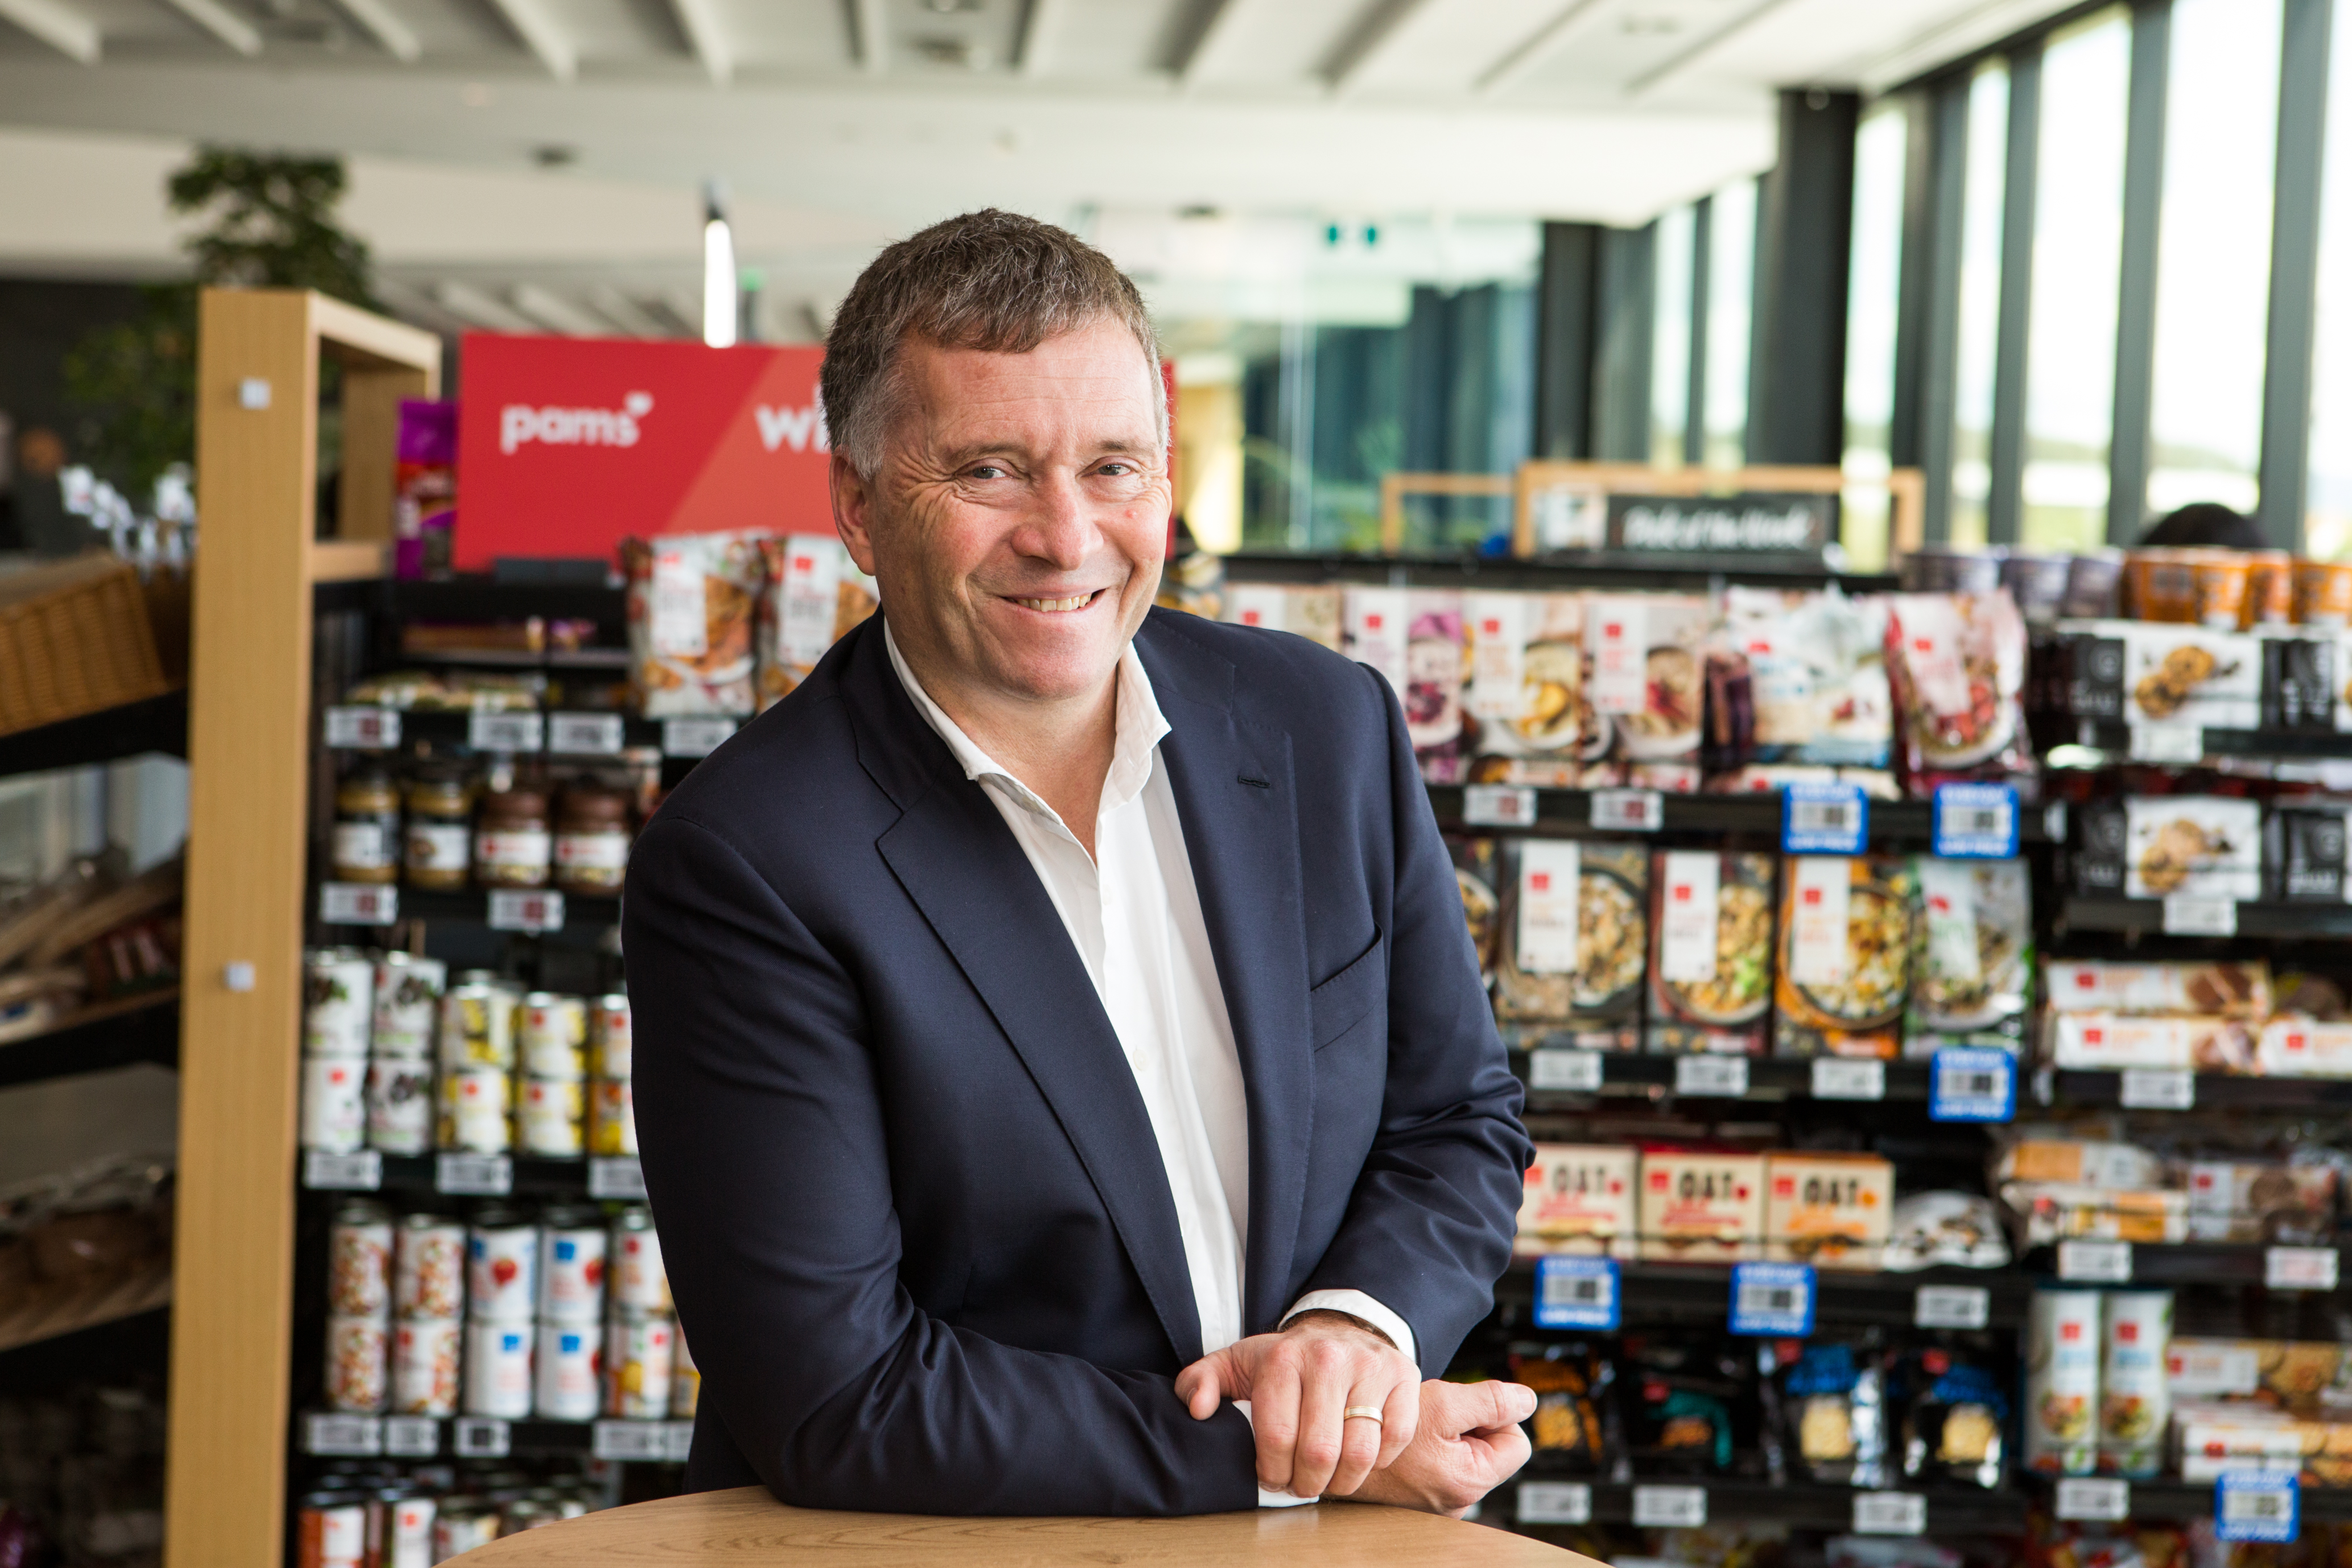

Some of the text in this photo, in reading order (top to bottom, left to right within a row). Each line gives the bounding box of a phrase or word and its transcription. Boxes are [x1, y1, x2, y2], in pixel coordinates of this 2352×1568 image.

[500, 402, 641, 455] pams
[1554, 1165, 1607, 1193] OAT
[1679, 1171, 1733, 1199] OAT
[1804, 1177, 1859, 1206] OAT
